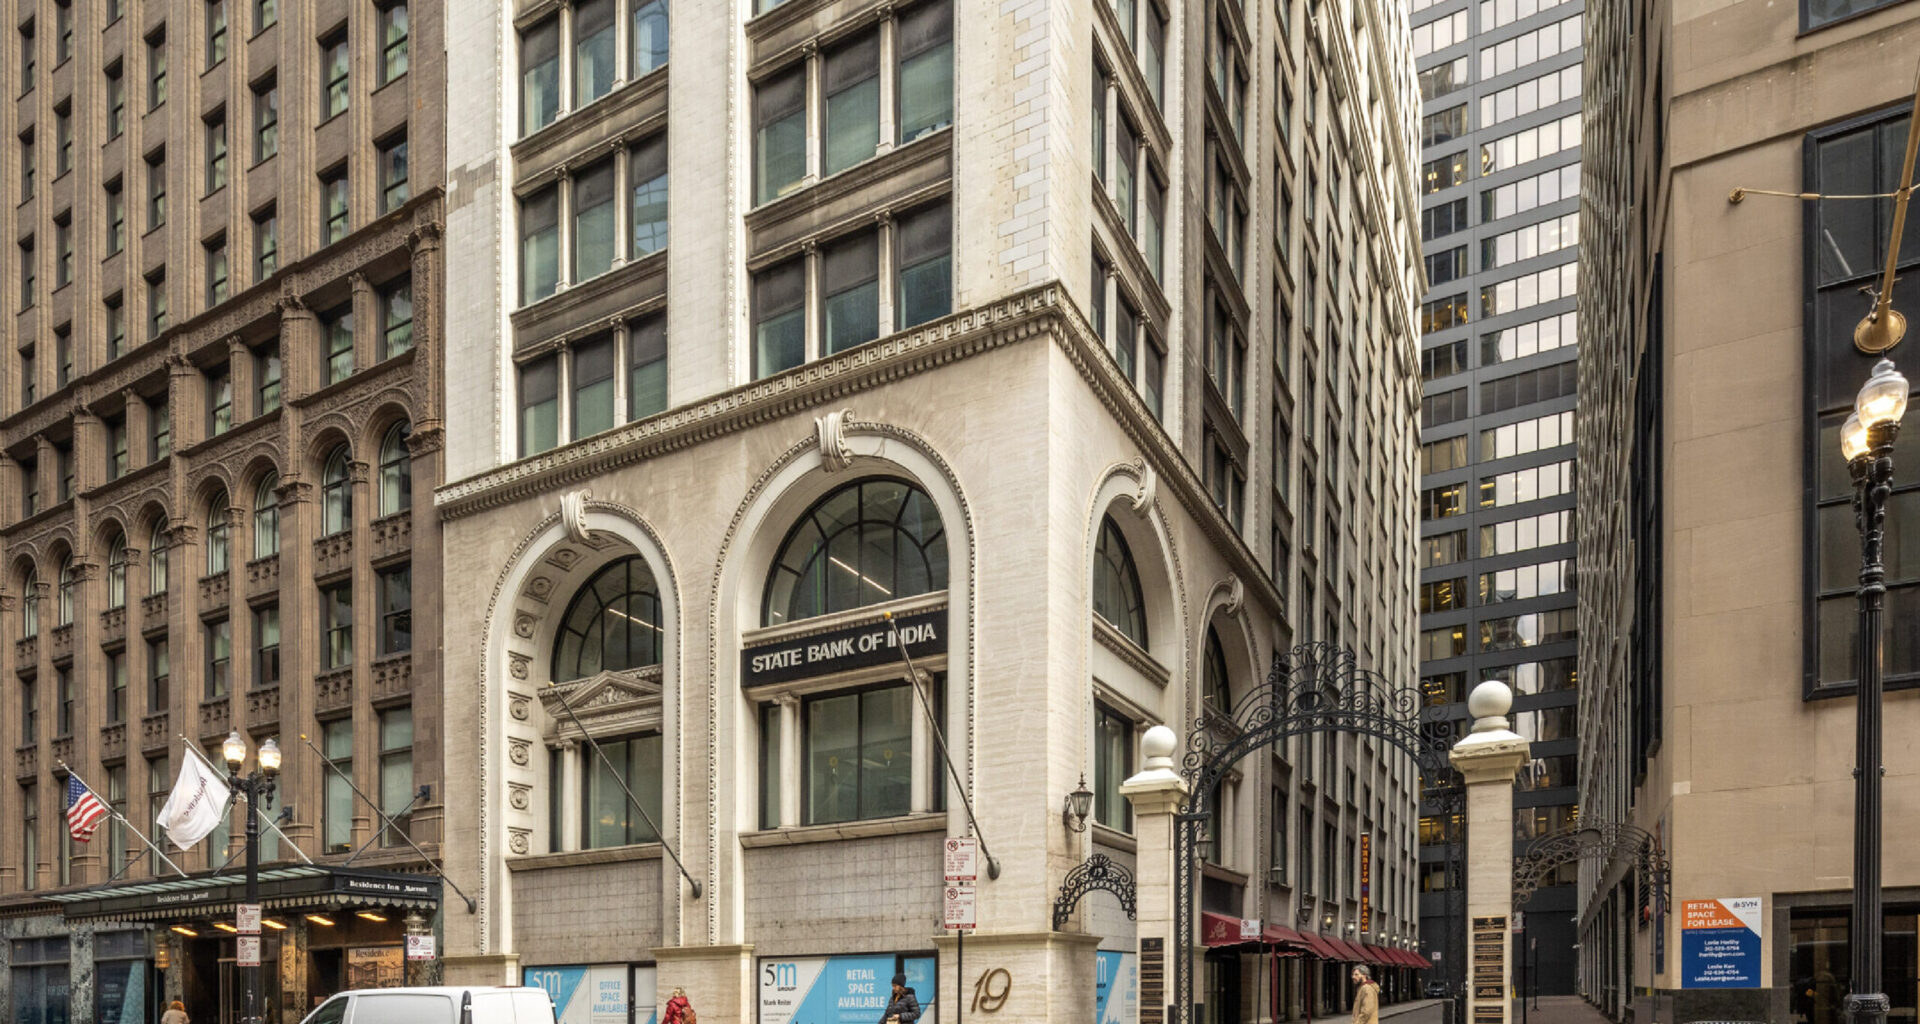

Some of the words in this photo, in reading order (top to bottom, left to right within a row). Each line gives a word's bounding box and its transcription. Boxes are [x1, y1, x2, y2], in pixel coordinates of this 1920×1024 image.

[752, 648, 802, 673] STATE
[807, 637, 855, 663] BANK
[858, 632, 884, 652] OF
[887, 623, 936, 648] INDIA
[349, 880, 386, 890] Residence
[387, 883, 400, 891] Inn
[157, 895, 180, 903] Residence
[1687, 902, 1718, 910] RETAIL
[1687, 911, 1715, 919] SPACE
[1706, 918, 1735, 926] LEASE
[355, 949, 390, 958] Residence
[846, 968, 876, 981] RETAIL
[599, 981, 621, 990] OFFICE
[848, 982, 875, 994] SPACE
[970, 967, 1012, 1015] 19
[599, 992, 620, 1002] SPACE
[838, 996, 886, 1008] AVAILABLE
[593, 1003, 628, 1013] AVAILABLE
